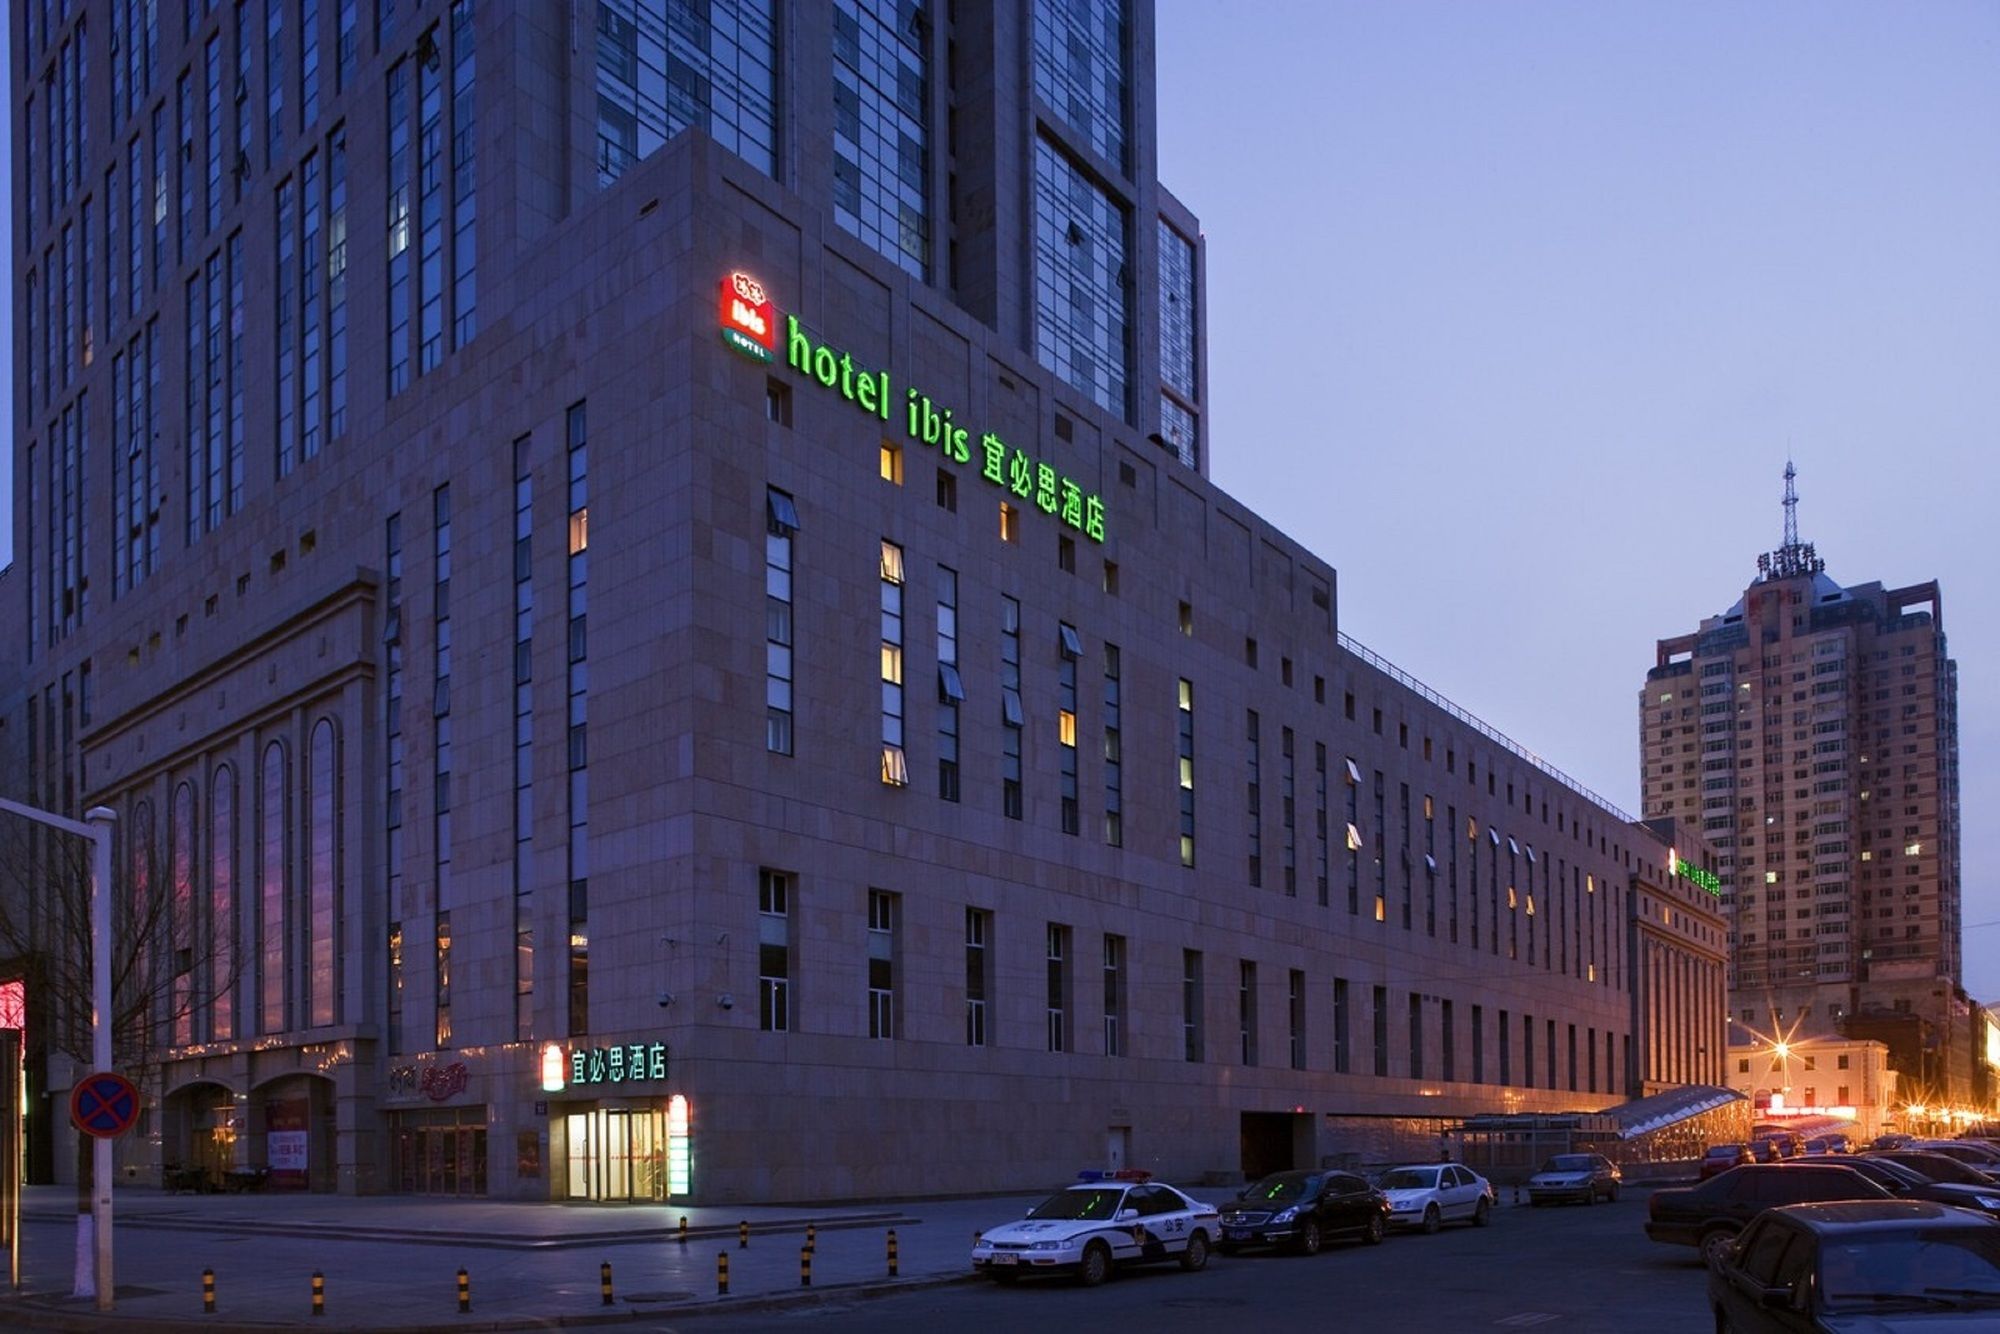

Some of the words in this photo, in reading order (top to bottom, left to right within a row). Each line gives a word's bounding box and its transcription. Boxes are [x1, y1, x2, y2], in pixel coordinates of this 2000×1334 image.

[733, 332, 765, 357] HOTEL
[787, 314, 889, 420] hotel
[907, 388, 970, 463] ibis
[982, 432, 1105, 543] 宜必思酒店
[571, 1041, 666, 1084] 宜必思酒店
